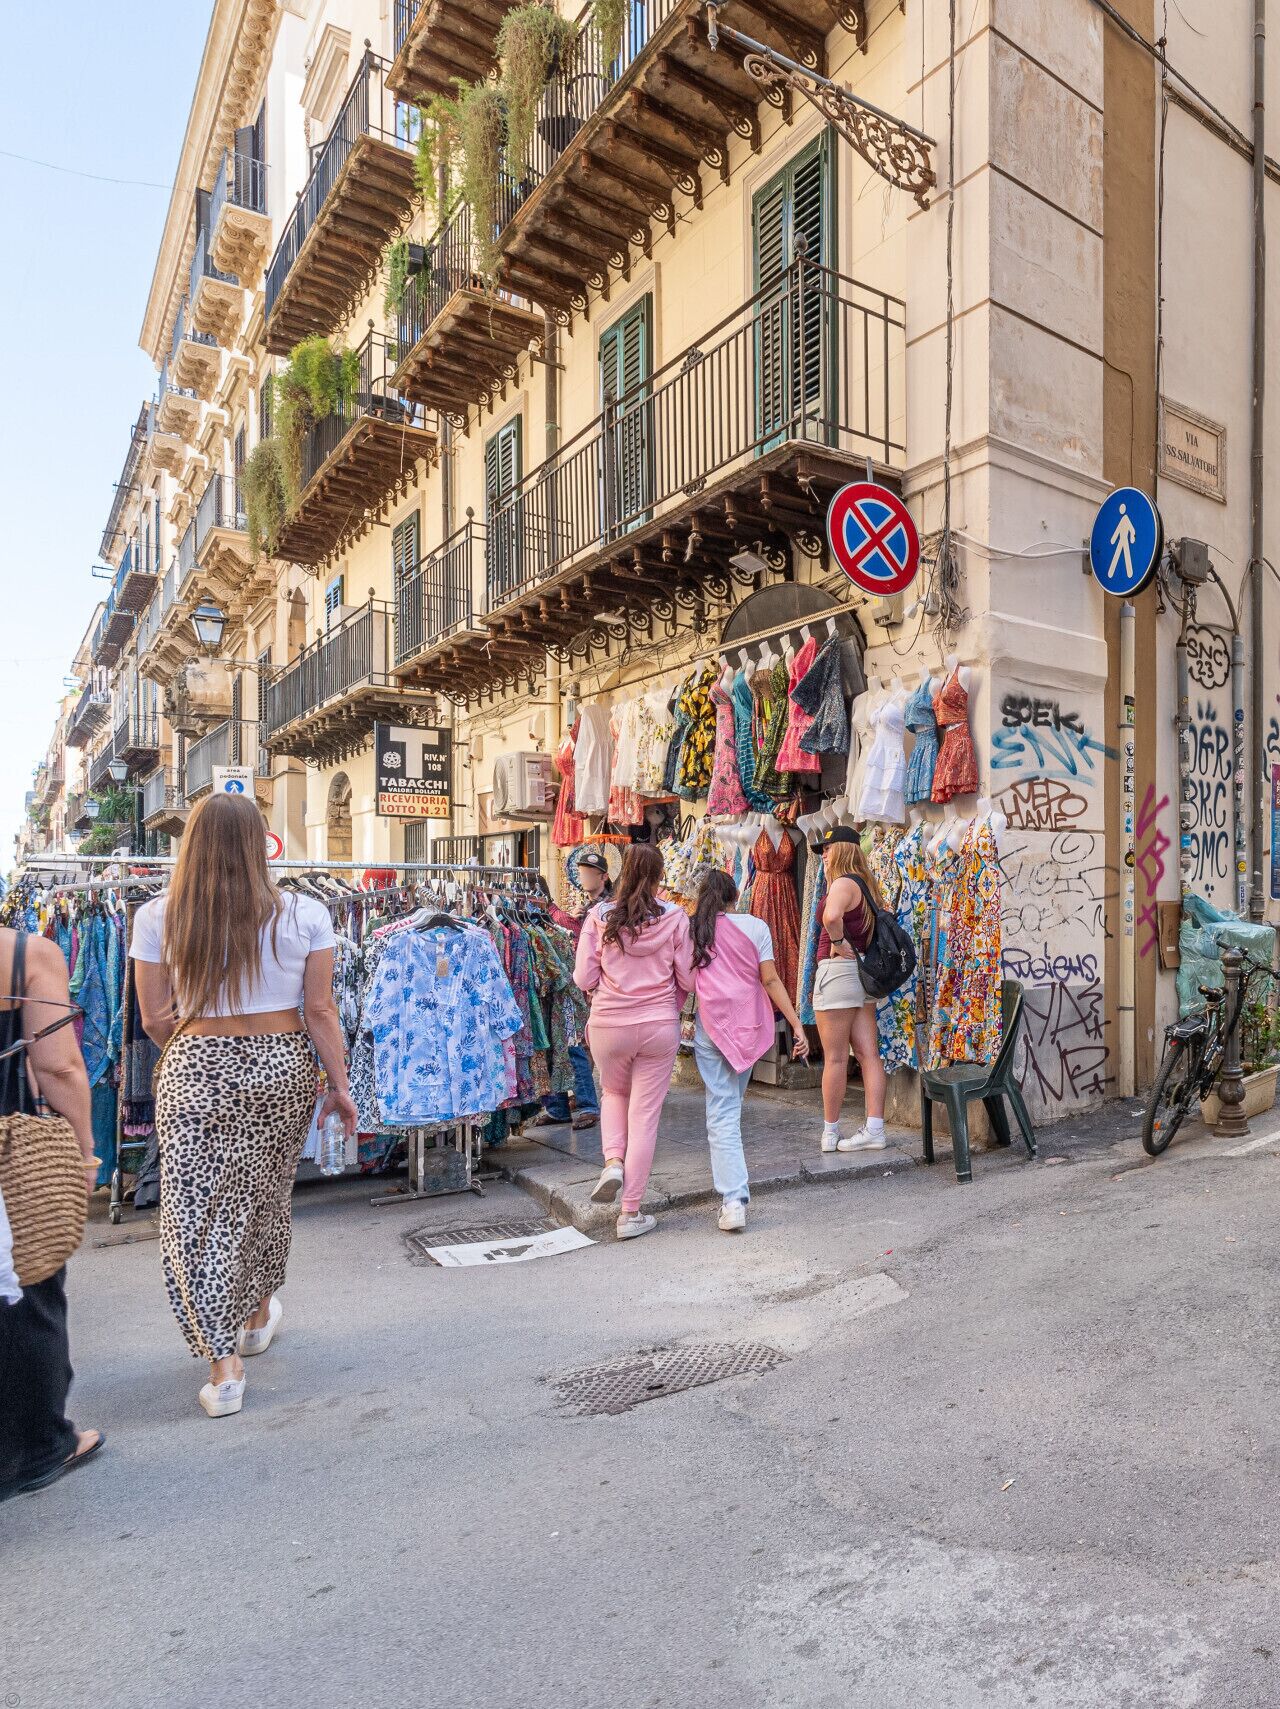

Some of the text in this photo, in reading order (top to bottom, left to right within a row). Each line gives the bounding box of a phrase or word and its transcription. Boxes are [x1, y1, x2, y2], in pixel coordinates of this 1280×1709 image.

[1186, 431, 1199, 448] VIA
[1166, 444, 1219, 477] SS.SALVATORE
[1186, 637, 1223, 667] SNC
[1196, 660, 1215, 679] 23
[389, 727, 439, 779] T
[424, 753, 439, 762] RIV.
[427, 763, 442, 771] 108
[380, 777, 448, 790] TABACCHI
[380, 794, 447, 805] RICEVITORIA
[381, 805, 416, 814] LOTTO
